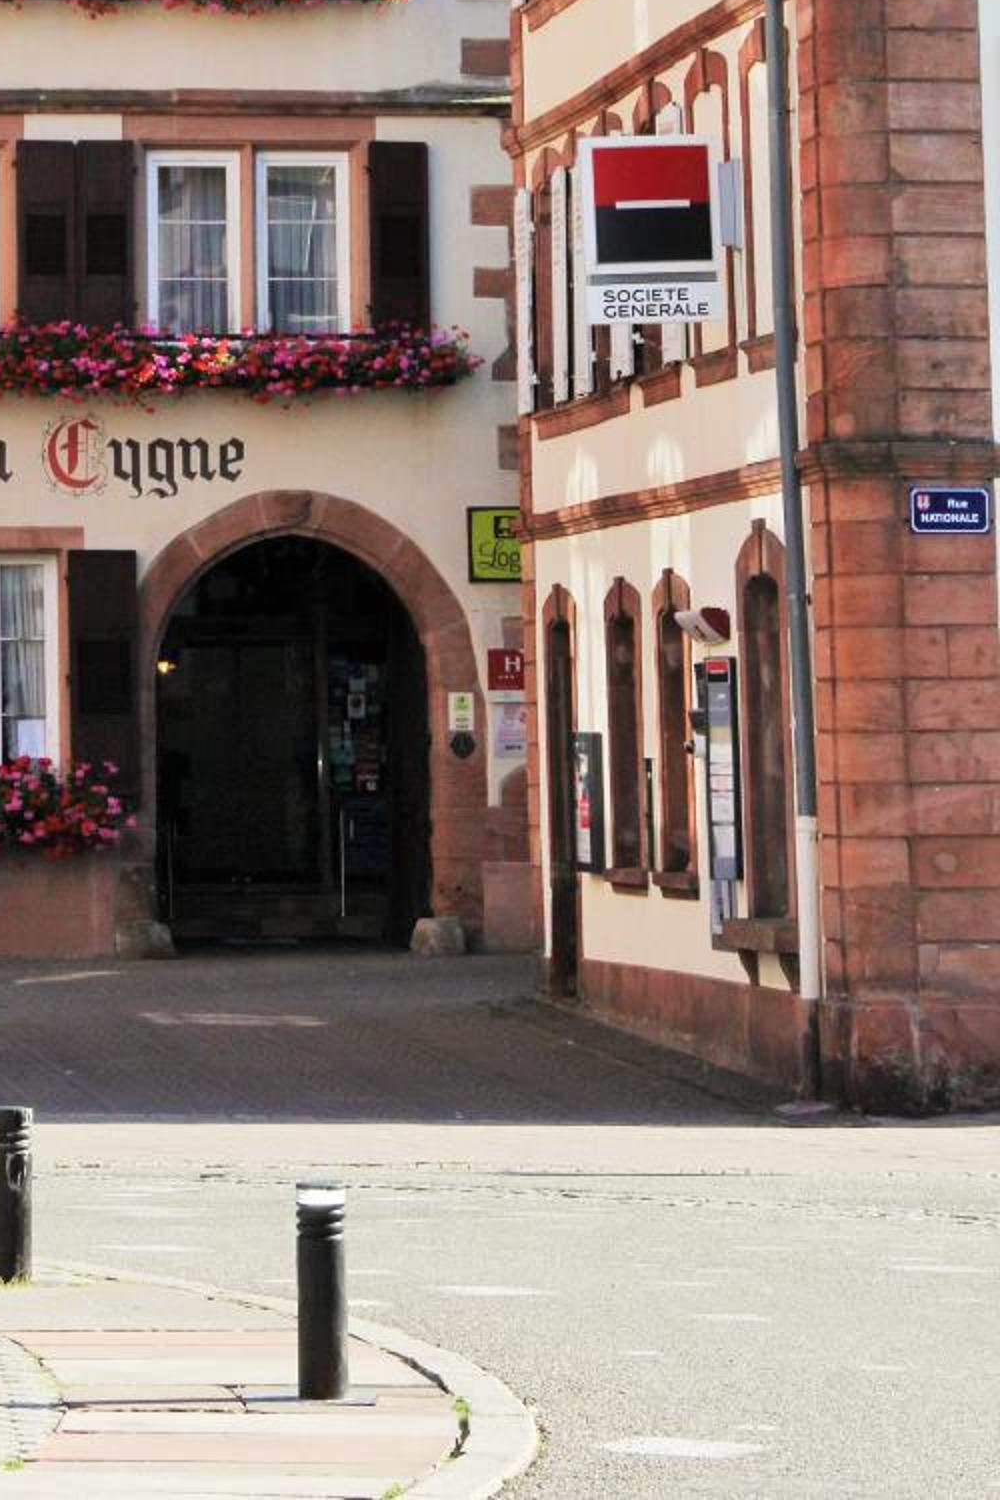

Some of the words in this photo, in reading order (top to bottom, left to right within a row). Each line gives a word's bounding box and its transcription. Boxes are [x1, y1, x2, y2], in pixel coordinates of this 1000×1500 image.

[603, 287, 689, 303] SOCIETE
[603, 302, 709, 318] GENERALE
[41, 411, 246, 499] Cygne
[947, 498, 968, 509] Rue
[921, 513, 979, 523] NATIONALE
[505, 656, 521, 672] H
